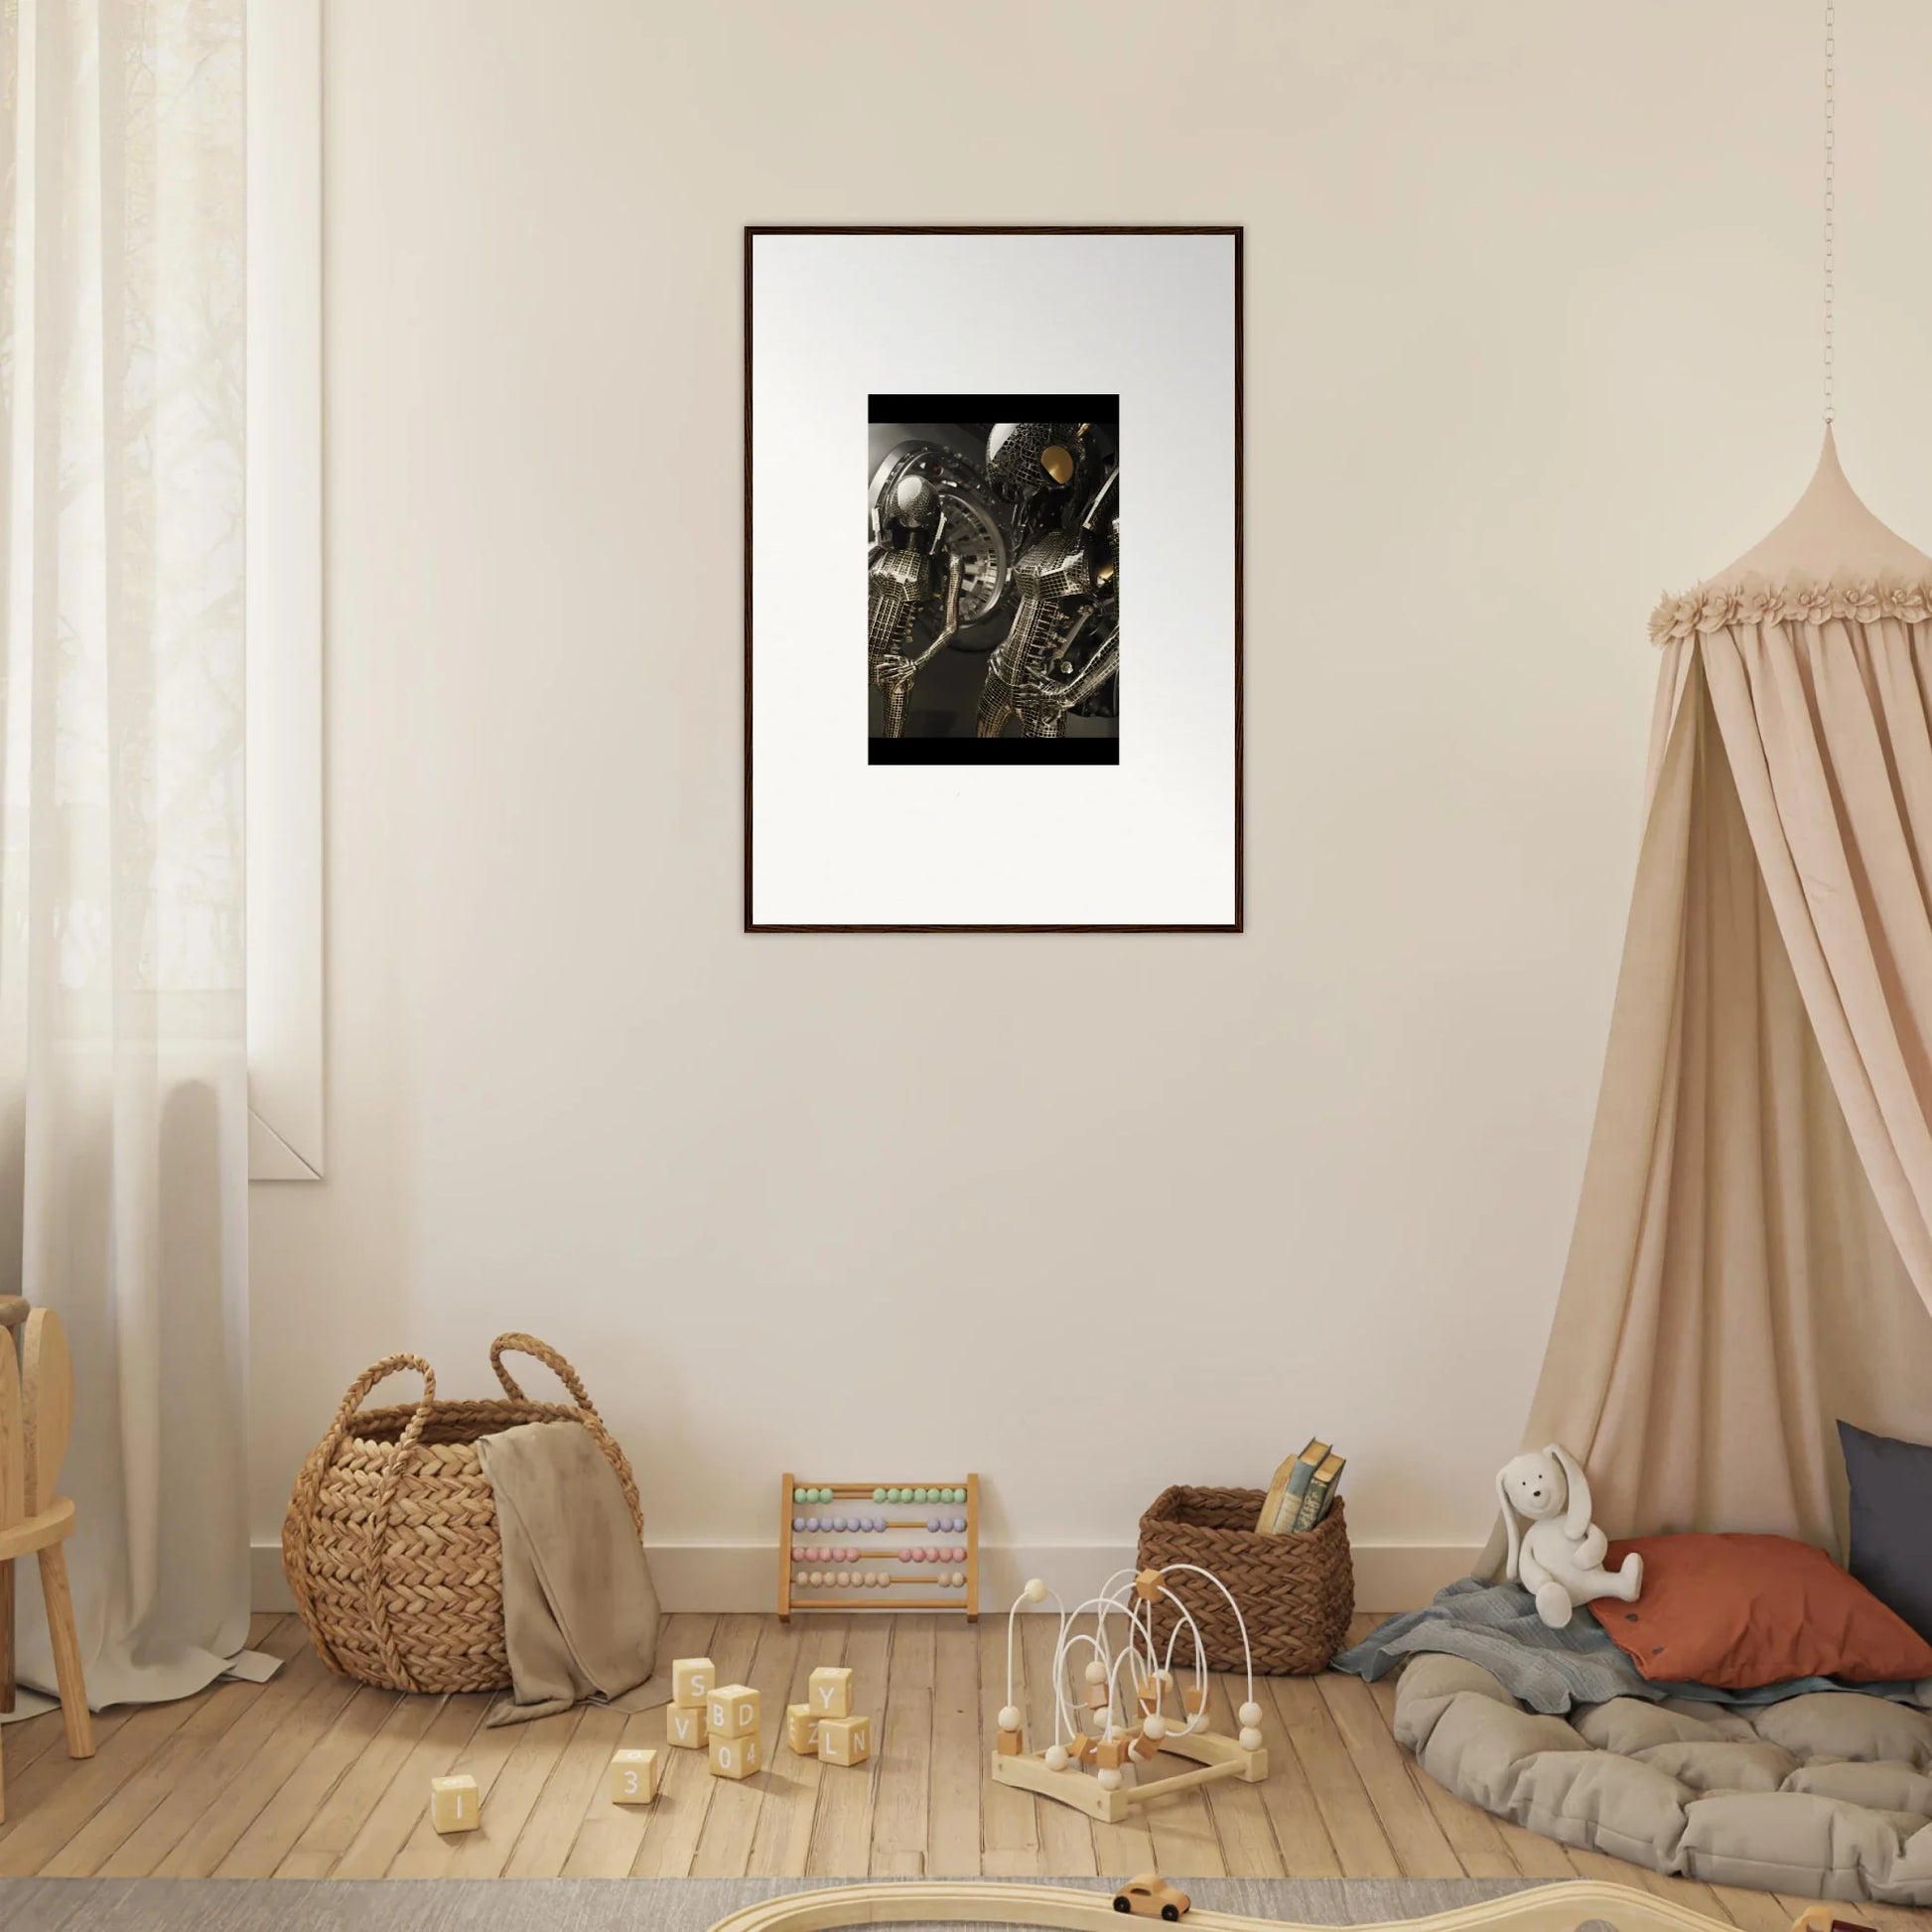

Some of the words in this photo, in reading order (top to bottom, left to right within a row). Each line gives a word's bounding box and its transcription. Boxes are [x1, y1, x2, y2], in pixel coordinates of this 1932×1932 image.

[691, 1675, 705, 1697] S
[818, 1687, 835, 1710] Y
[713, 1704, 725, 1726] B
[740, 1704, 753, 1726] D
[675, 1717, 690, 1740] V
[825, 1732, 837, 1755] L
[854, 1729, 866, 1754] N
[623, 1770, 638, 1795] 3
